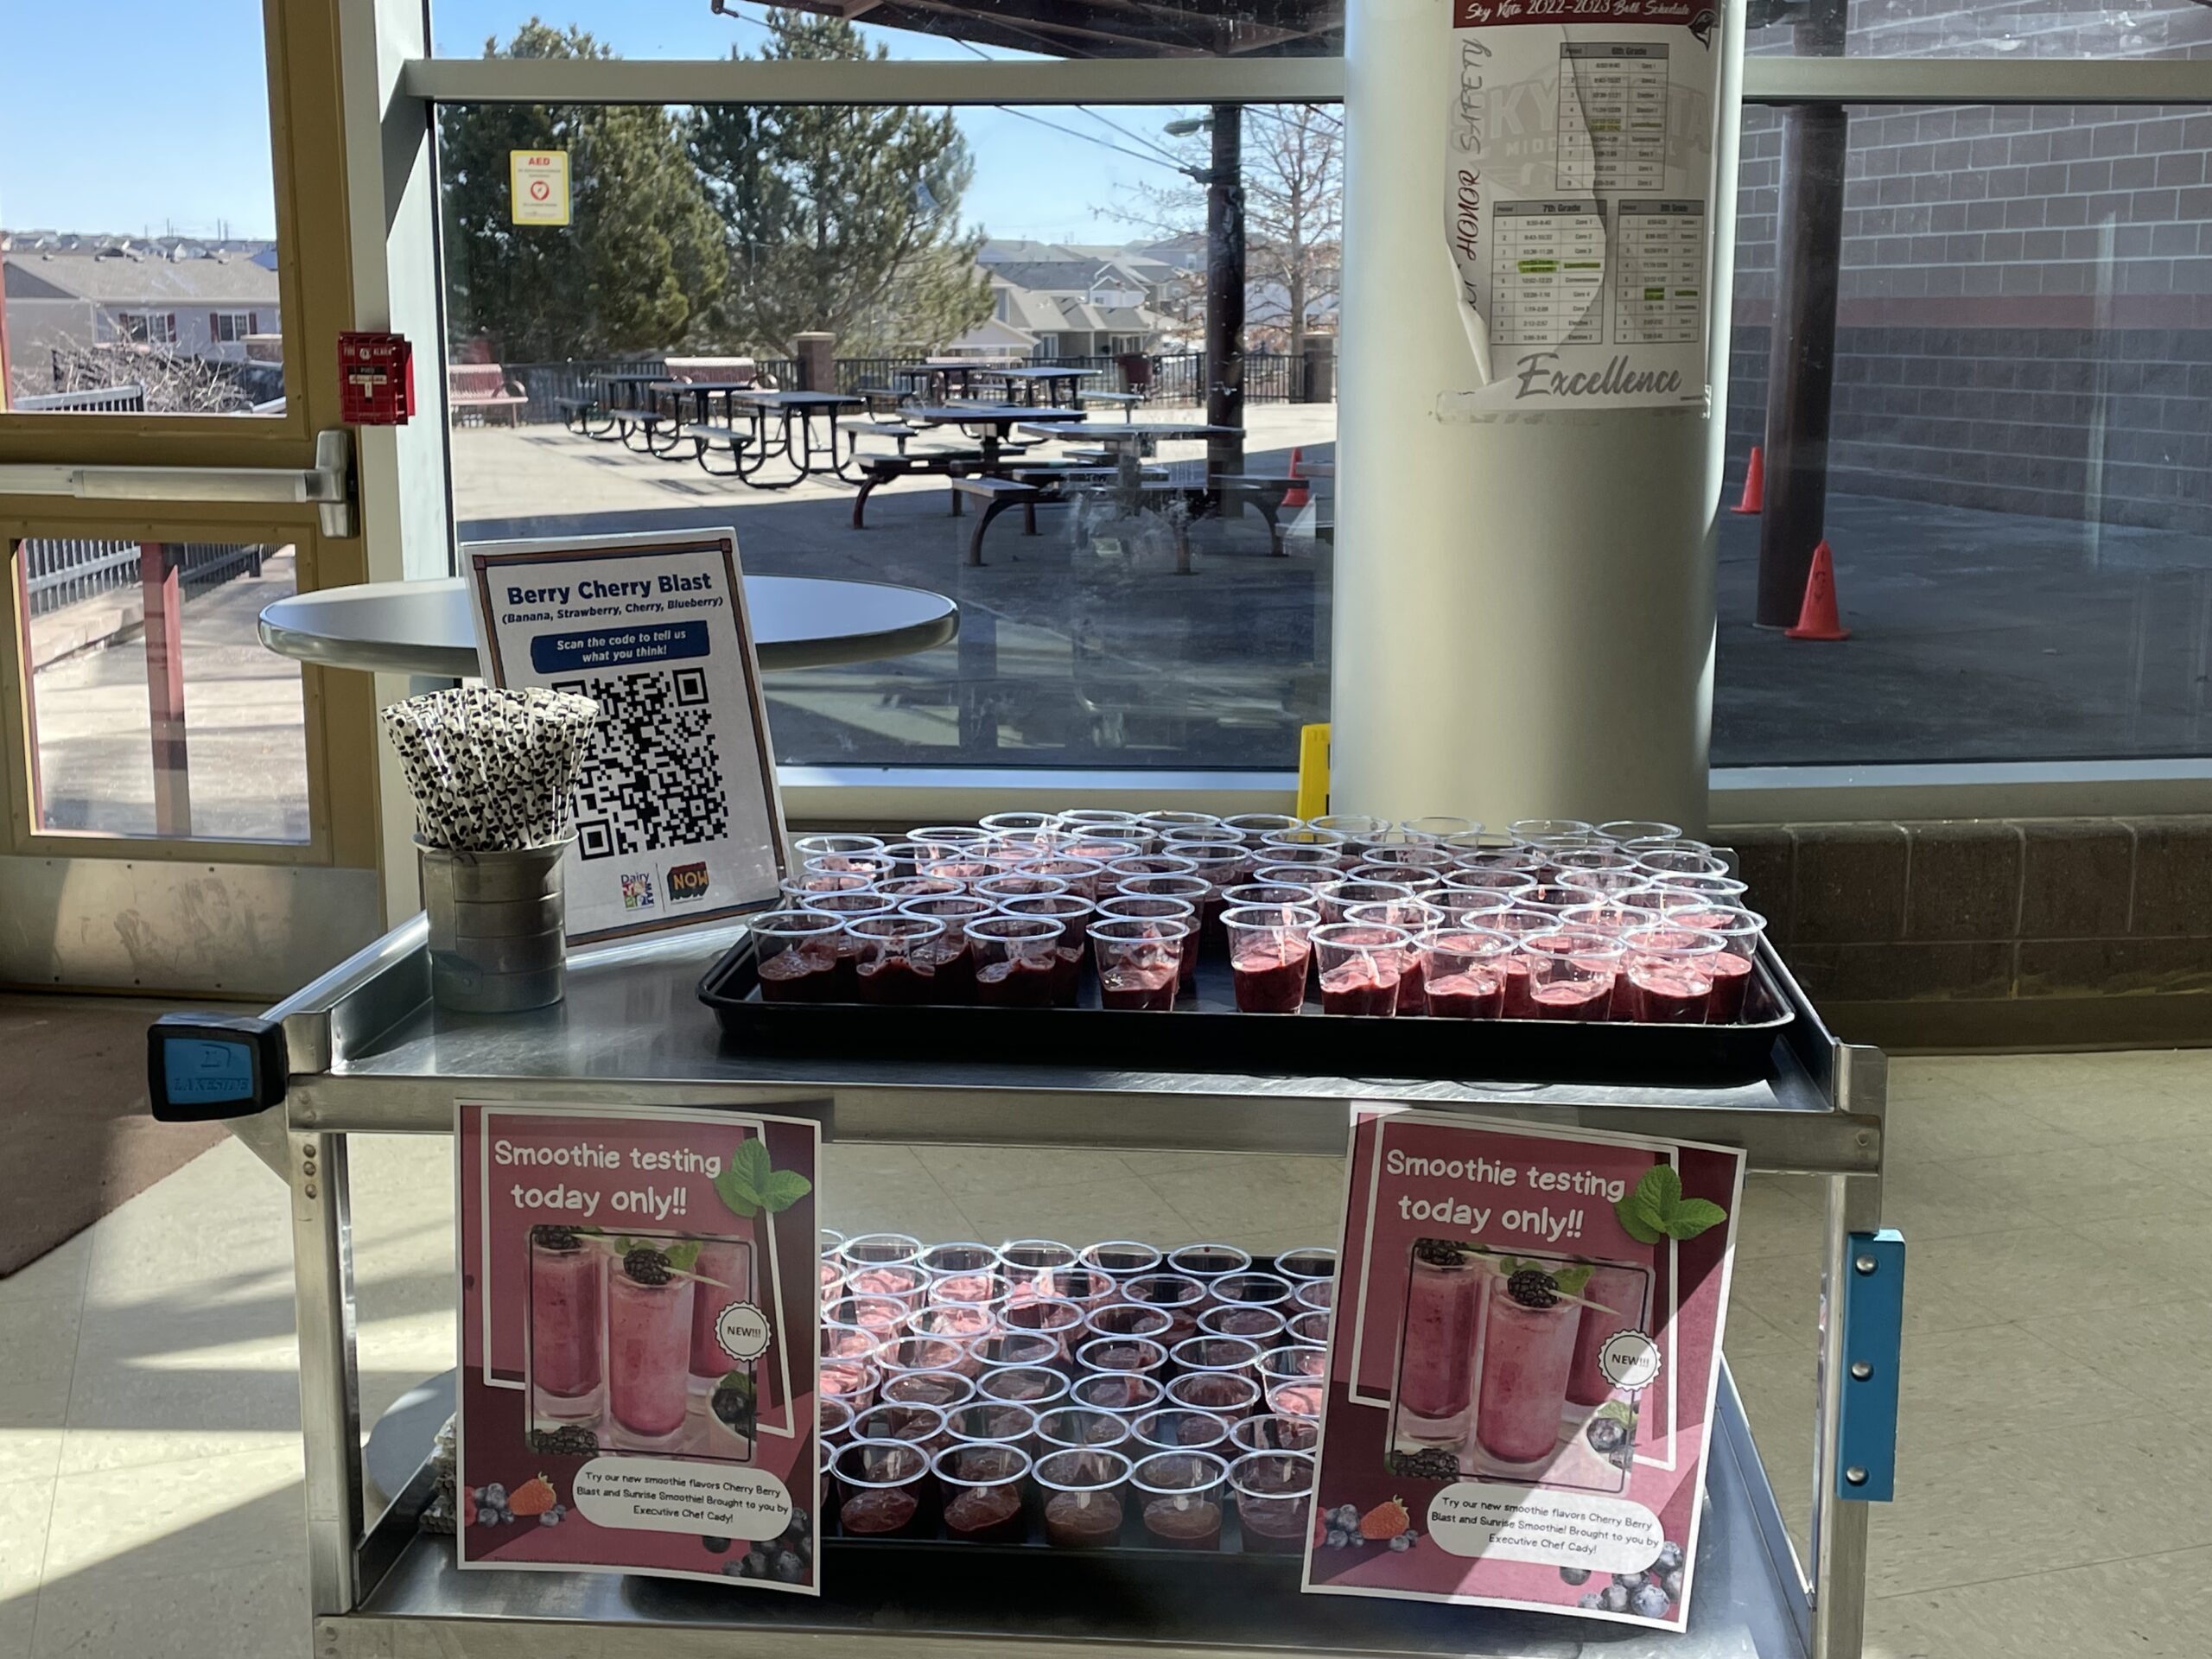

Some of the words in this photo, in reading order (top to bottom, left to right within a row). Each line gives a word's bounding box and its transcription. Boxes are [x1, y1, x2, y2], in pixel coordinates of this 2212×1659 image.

[1465, 3, 1491, 22] Sky
[1497, 0, 1522, 18] Vista
[1526, 0, 1610, 15] 2022-2023
[1460, 38, 1492, 155] SAFETY
[528, 156, 550, 166] AED
[1457, 169, 1481, 261] HONOR
[1542, 204, 1556, 213] 7th
[1558, 204, 1581, 213] Grade
[1515, 352, 1682, 399] Excellence
[507, 586, 570, 605] Berry
[578, 578, 652, 599] Cherry
[658, 572, 712, 593] Blast
[502, 611, 554, 625] (Banana,
[556, 606, 622, 620] Strawberry,
[625, 601, 664, 614] Cherry,
[667, 596, 723, 610] Blueberry)
[556, 639, 584, 651] Scan
[587, 637, 606, 648] the
[608, 633, 636, 645] code
[638, 632, 651, 643] to
[652, 630, 671, 641] tell
[673, 631, 686, 640] us
[582, 651, 609, 664] what
[613, 649, 632, 662] you
[635, 645, 667, 658] think!
[620, 872, 650, 884] Dairy
[673, 870, 709, 891] NOW
[174, 1077, 249, 1092] LAKESIDE
[494, 1139, 620, 1169] Smoothie
[629, 1147, 721, 1179] testing
[1386, 1148, 1517, 1187] Smoothie
[1526, 1166, 1626, 1204] testing
[511, 1183, 601, 1218] today
[611, 1185, 687, 1221] only!!
[1397, 1195, 1491, 1235] today
[1501, 1206, 1584, 1243] only!!
[727, 1325, 761, 1338] NEW!!!
[1611, 1354, 1649, 1369] NEW!!!
[585, 1471, 602, 1484] Try
[622, 1475, 642, 1484] new
[645, 1475, 686, 1487] smoothie
[689, 1478, 721, 1491] flavors
[722, 1482, 754, 1496] Cherry
[756, 1485, 781, 1498] Berry
[576, 1486, 601, 1497] Blast
[603, 1487, 620, 1497] and
[623, 1489, 657, 1500] Sunrise
[659, 1491, 705, 1503] Smoothie!
[707, 1495, 744, 1510] Brought
[746, 1500, 756, 1510] to
[759, 1503, 776, 1514] you
[777, 1503, 790, 1516] by
[633, 1504, 679, 1518] Executive
[682, 1508, 705, 1520] Chef
[707, 1510, 734, 1524] Cady!
[1442, 1497, 1460, 1510] Try
[1462, 1499, 1478, 1510] our
[1481, 1502, 1502, 1511] new
[1503, 1503, 1549, 1517] smoothie
[1552, 1507, 1586, 1521] flavors
[1588, 1512, 1623, 1528] Cherry
[1624, 1517, 1653, 1532] Berry
[1431, 1511, 1456, 1523] Blast
[1459, 1514, 1478, 1525] and
[1480, 1516, 1515, 1529] Sunrise
[1517, 1520, 1567, 1535] Smoothie!
[1568, 1526, 1609, 1541] Brought
[1611, 1532, 1624, 1541] to
[1625, 1535, 1644, 1547] you
[1646, 1537, 1660, 1549] by
[1488, 1533, 1538, 1548] Executive
[1541, 1538, 1566, 1551] Chef
[1567, 1541, 1598, 1555] Cady!
